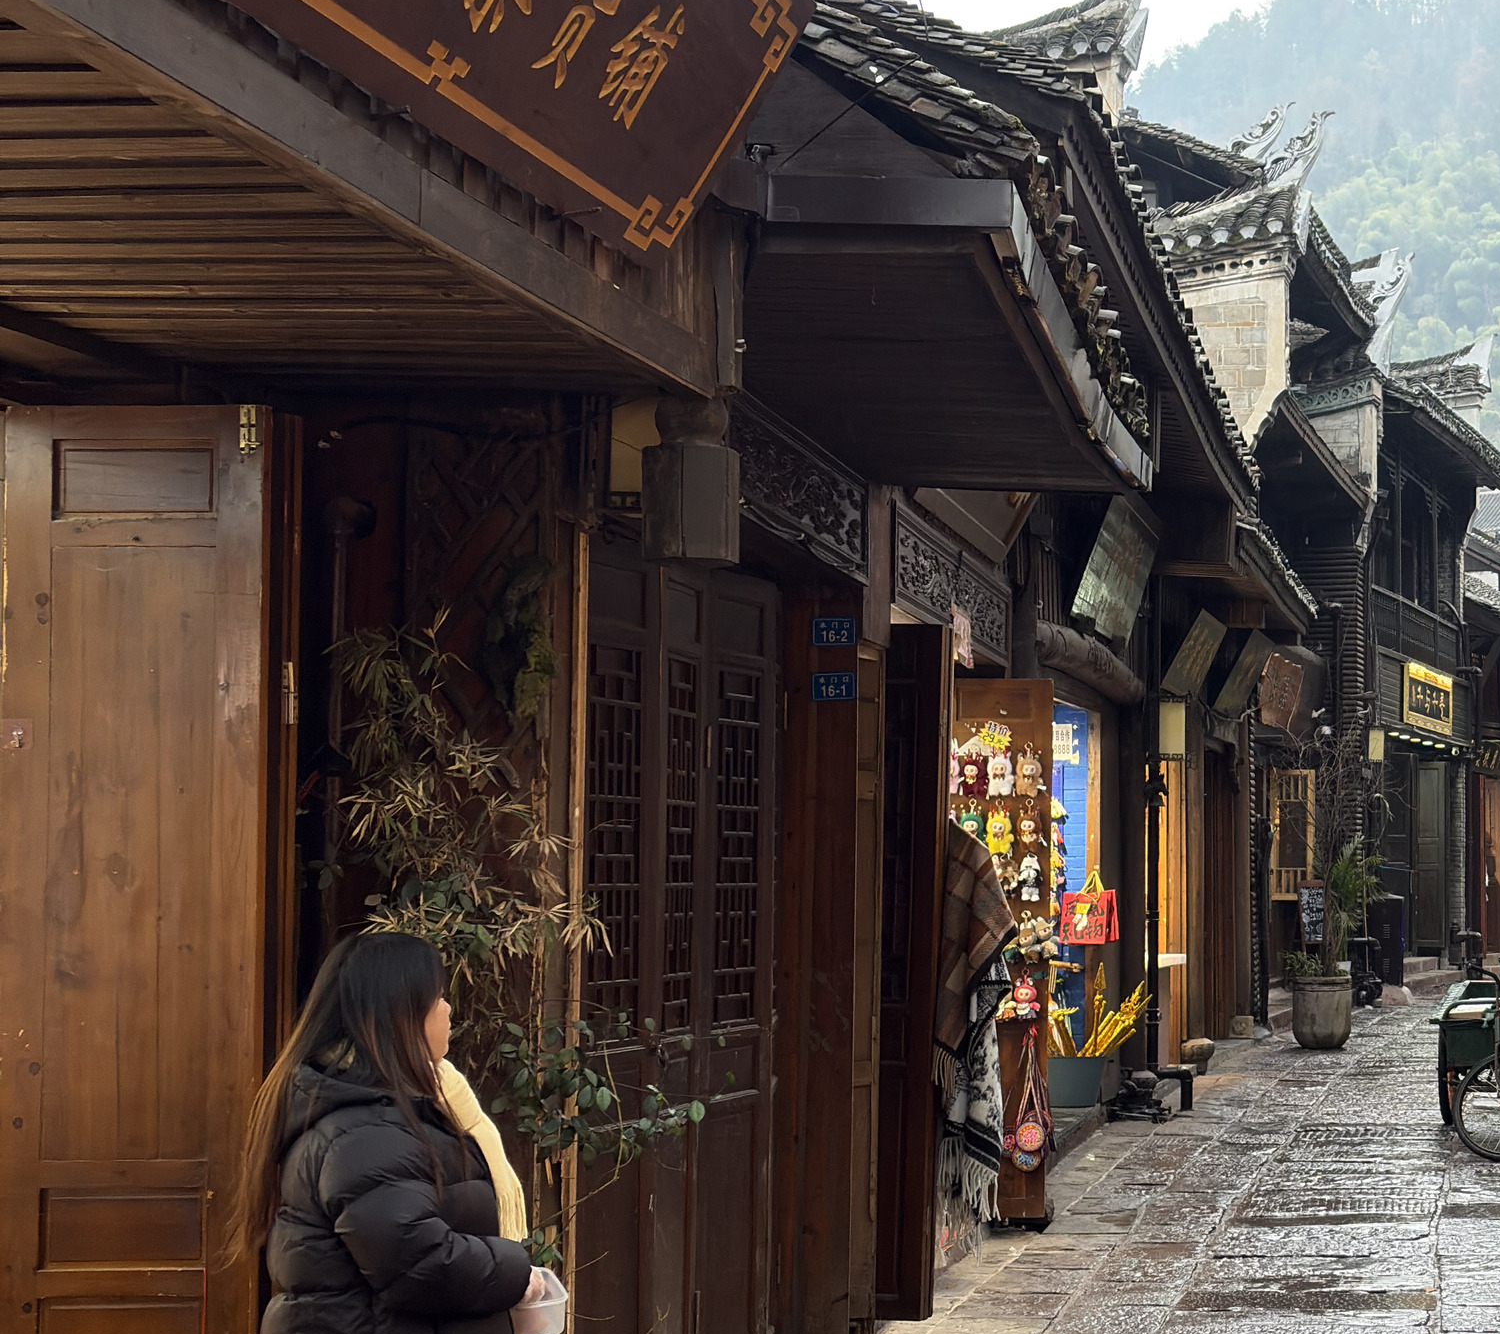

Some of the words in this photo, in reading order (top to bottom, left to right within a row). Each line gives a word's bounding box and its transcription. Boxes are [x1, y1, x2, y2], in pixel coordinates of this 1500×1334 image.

[820, 630, 848, 642] 16-2
[820, 684, 847, 697] 16-1
[987, 721, 1009, 737] 特价
